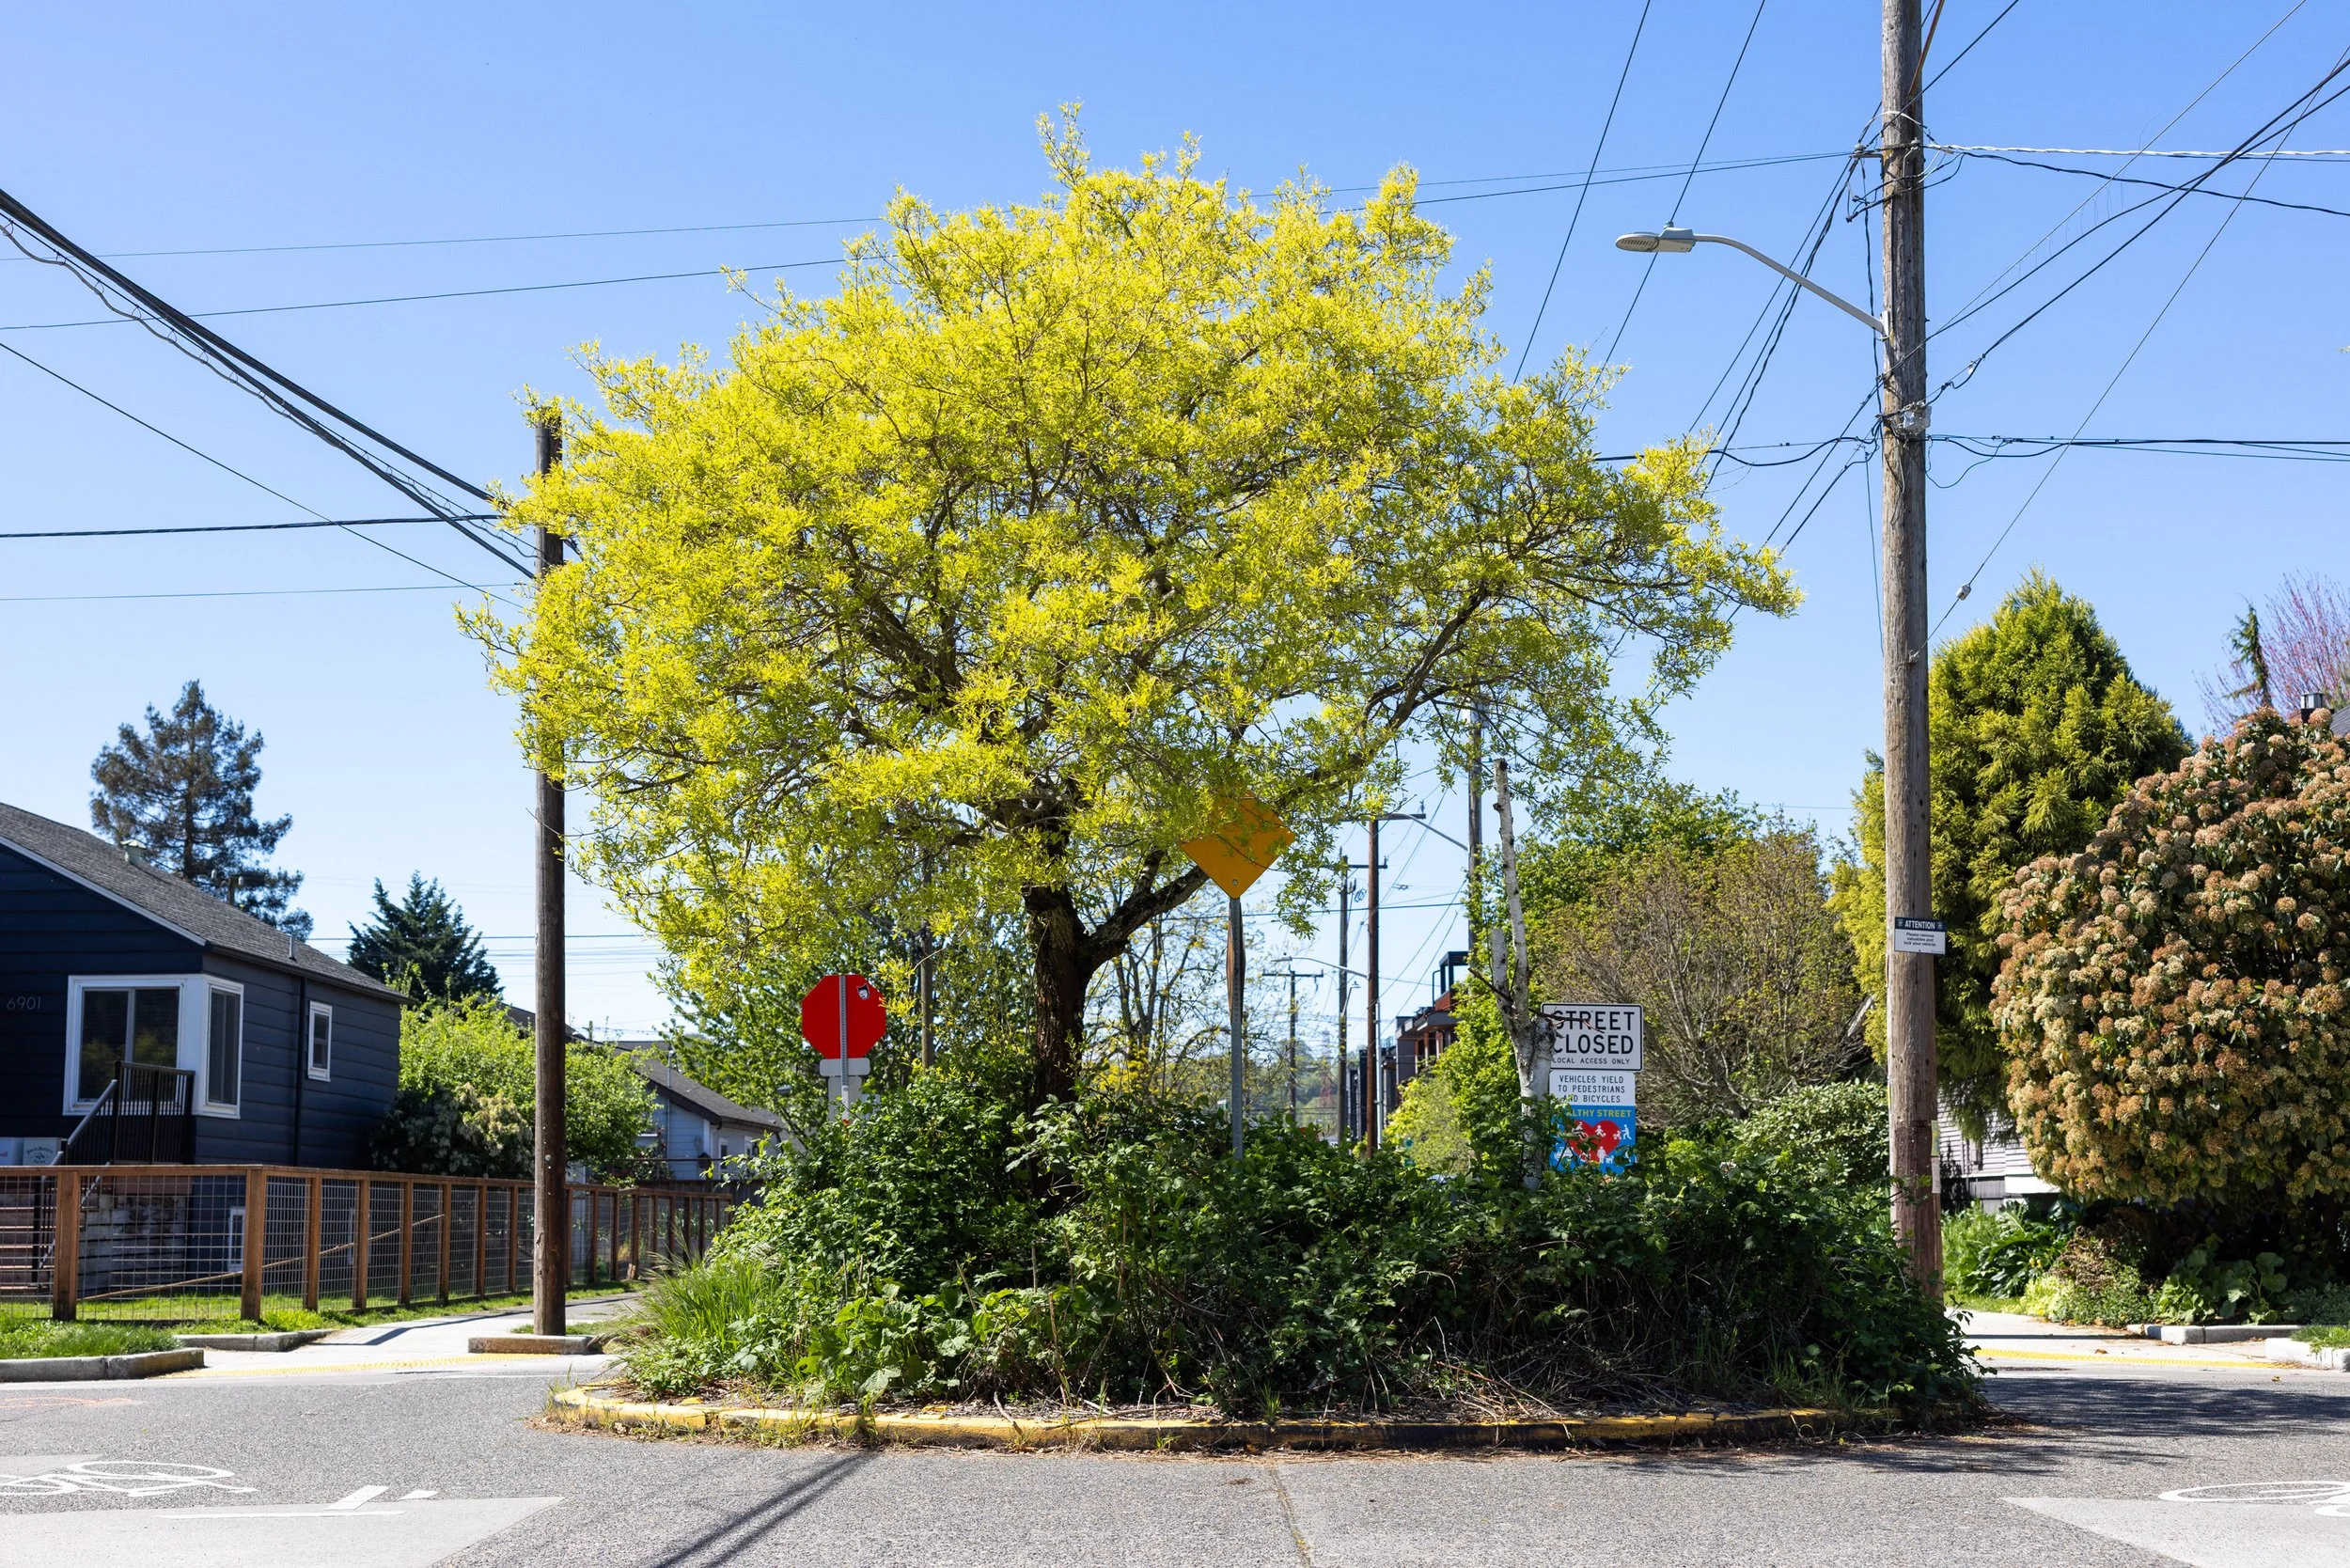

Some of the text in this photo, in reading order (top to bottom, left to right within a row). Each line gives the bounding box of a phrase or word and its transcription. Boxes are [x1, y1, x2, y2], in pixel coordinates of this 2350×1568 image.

[1904, 920, 1935, 930] ATTENTION
[7, 996, 41, 1011] 6901
[1553, 1011, 1635, 1030] STREET
[1602, 1075, 1624, 1084] YIELD
[1558, 1084, 1625, 1093] TO PEDESTRIANS
[1583, 1094, 1621, 1103] BICYCLES
[1596, 1109, 1632, 1118] STREET
